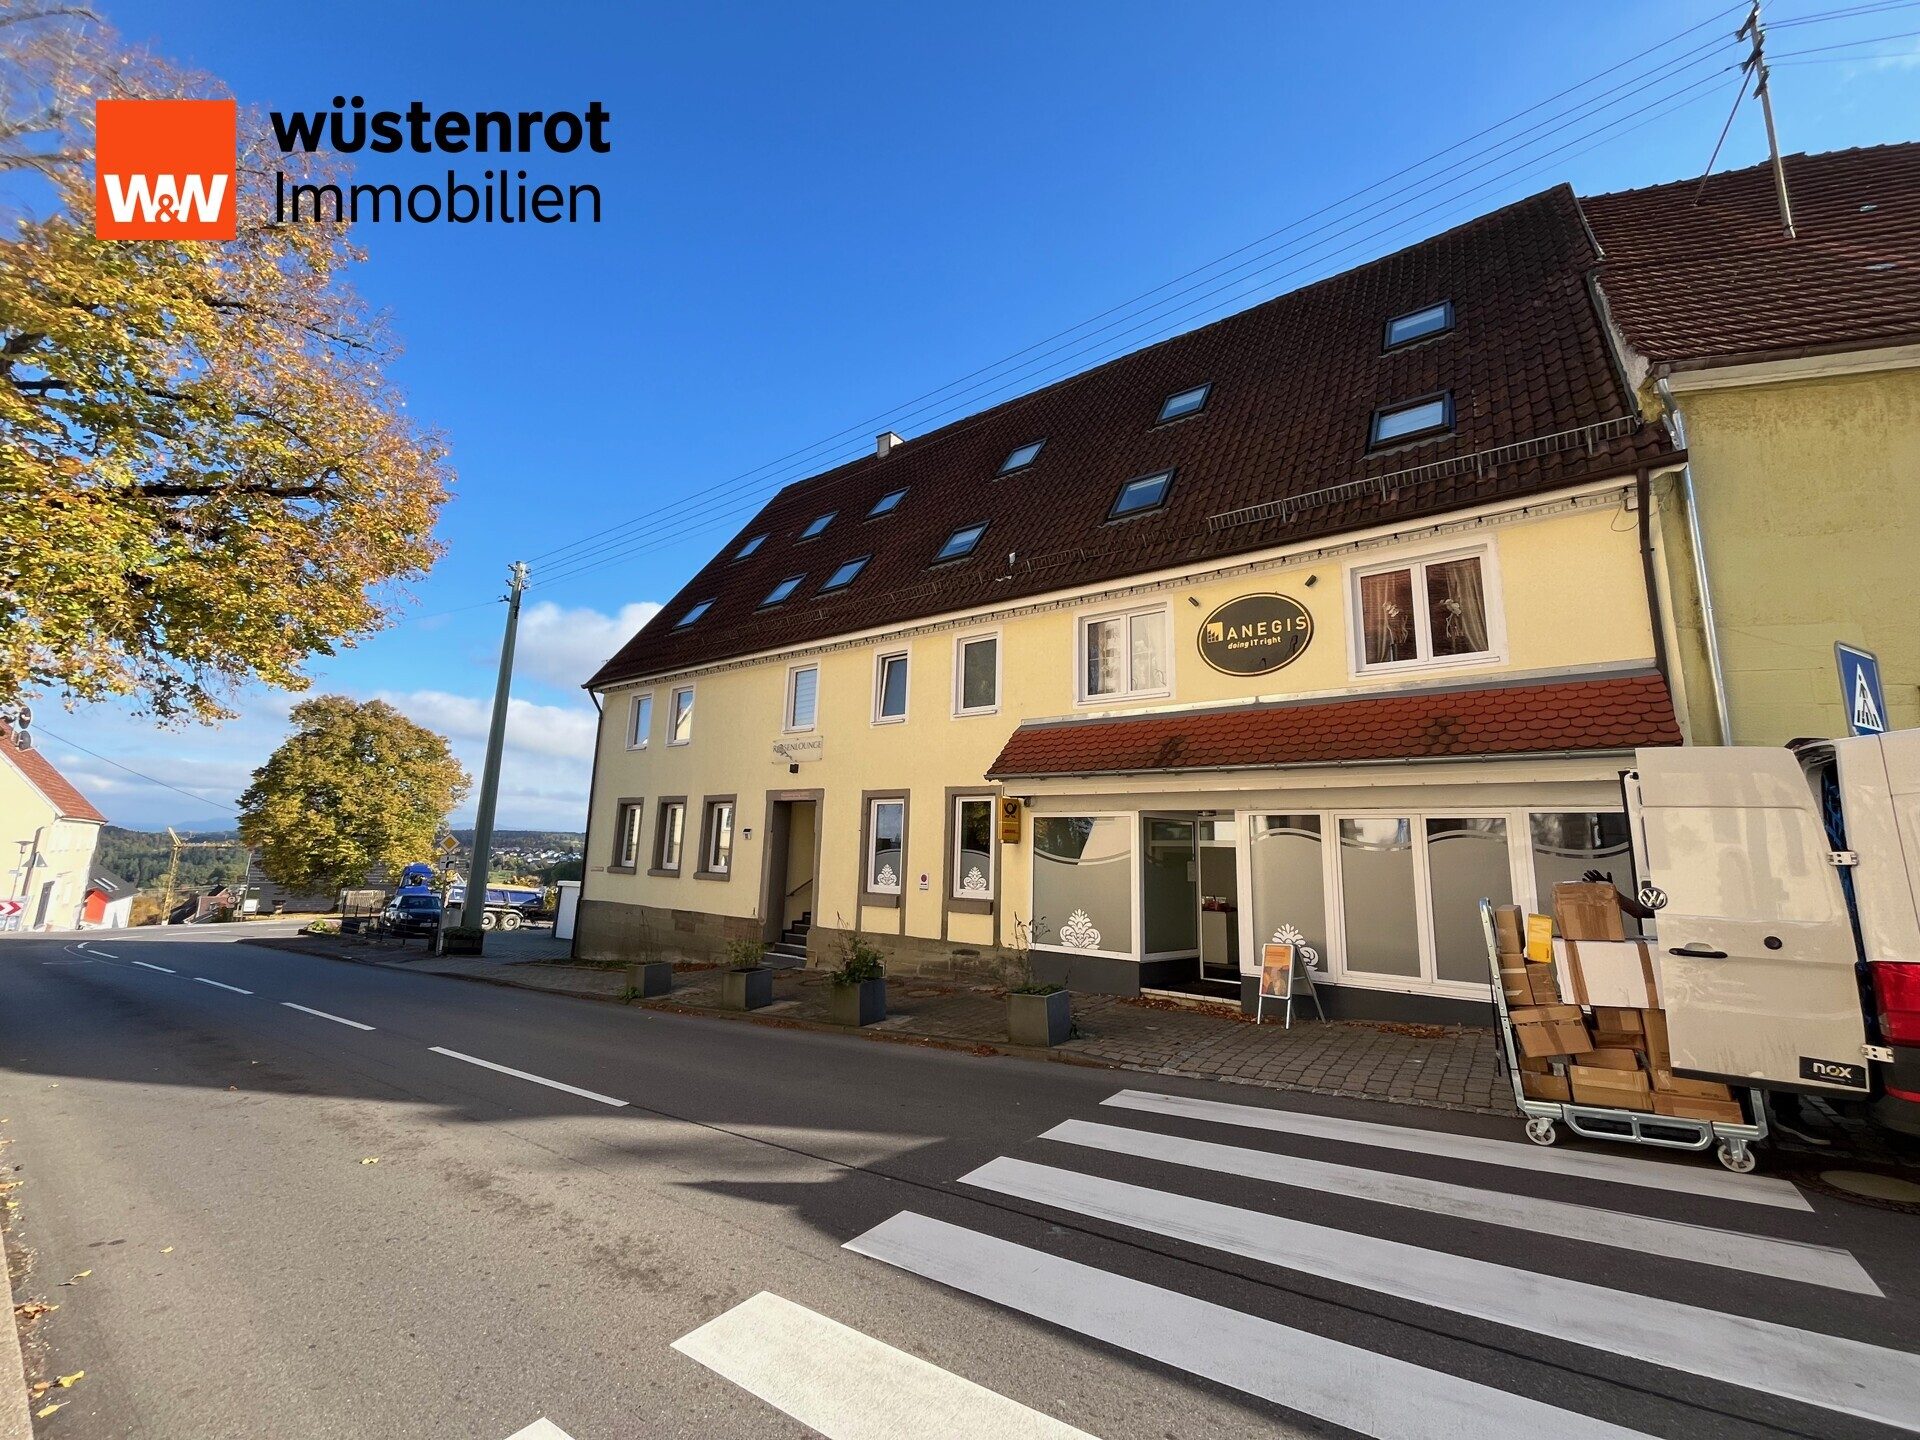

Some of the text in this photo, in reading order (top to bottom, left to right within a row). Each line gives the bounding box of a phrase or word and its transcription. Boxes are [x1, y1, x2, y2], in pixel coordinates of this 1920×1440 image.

[1226, 616, 1307, 641] ANEGIS
[1227, 640, 1249, 650] doing
[1259, 636, 1281, 646] right
[772, 740, 822, 753] RSENLOUNGE
[1812, 1062, 1852, 1079] nox
